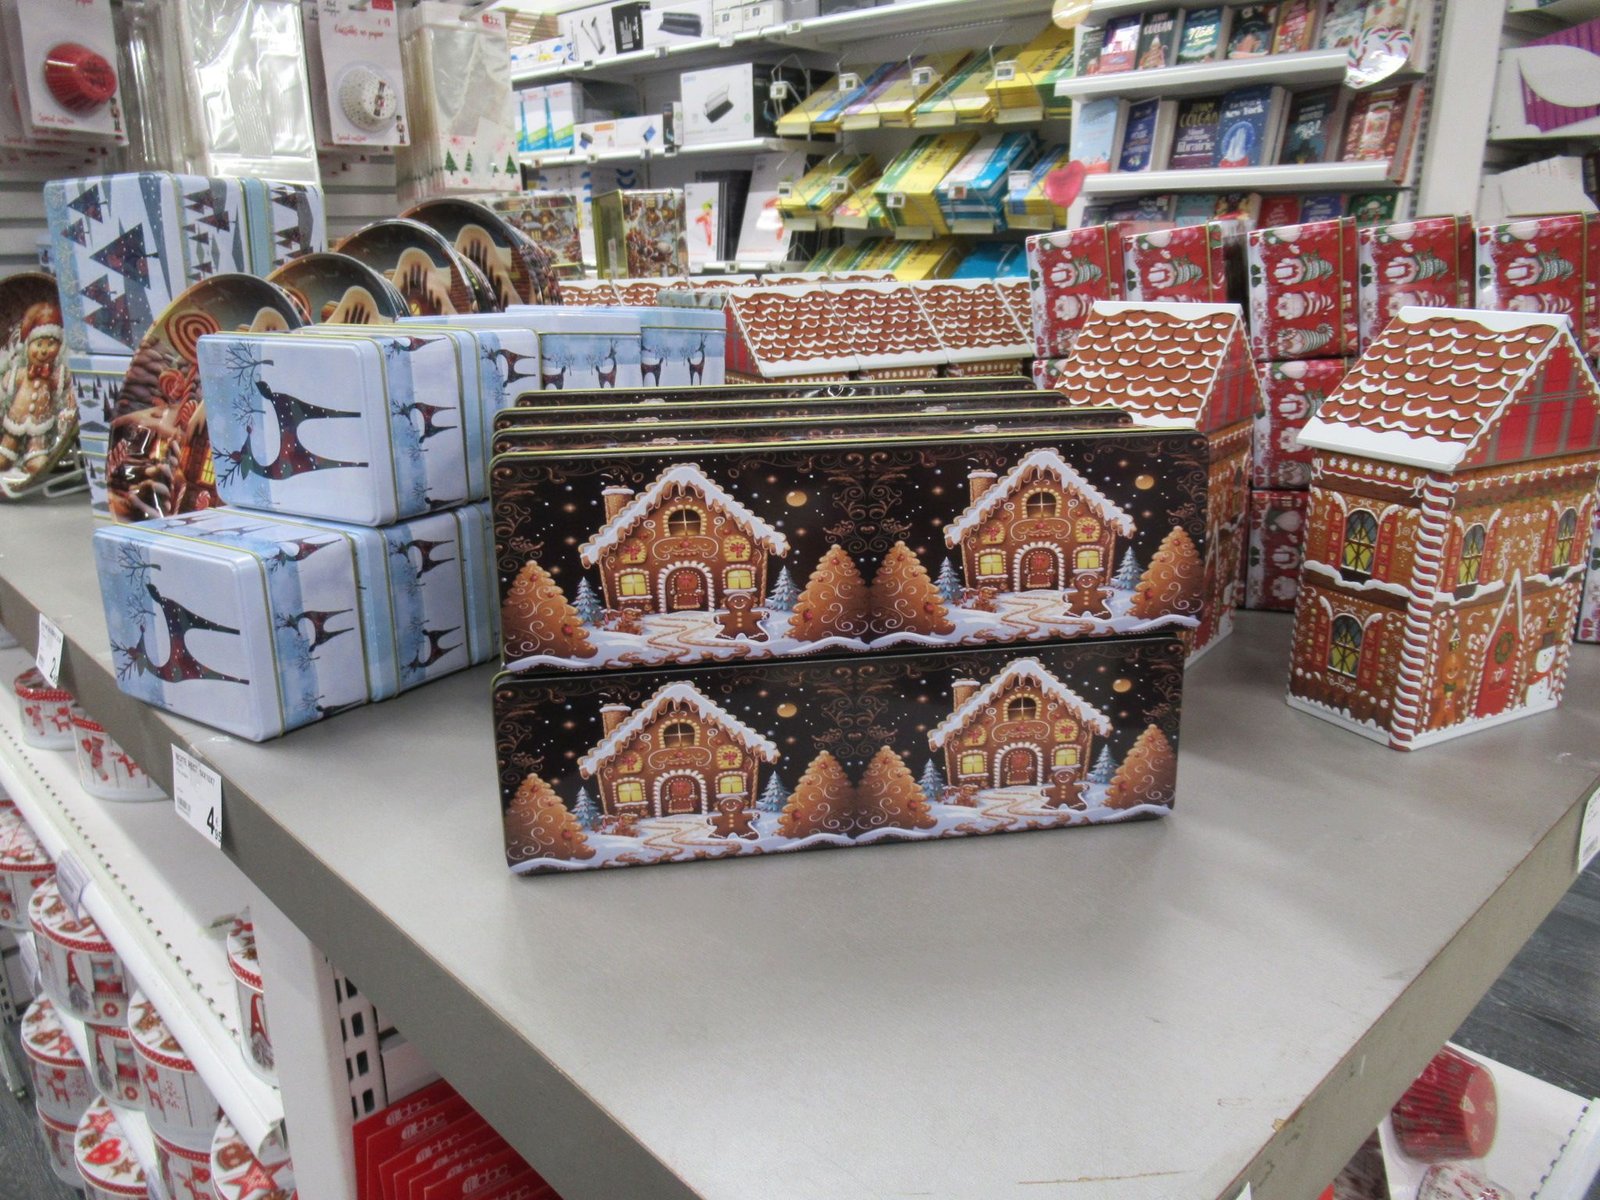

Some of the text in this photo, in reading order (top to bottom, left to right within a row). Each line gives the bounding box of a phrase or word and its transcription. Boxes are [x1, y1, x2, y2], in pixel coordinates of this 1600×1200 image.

[1225, 109, 1242, 118] New
[1243, 103, 1265, 116] York
[206, 805, 216, 836] 4
